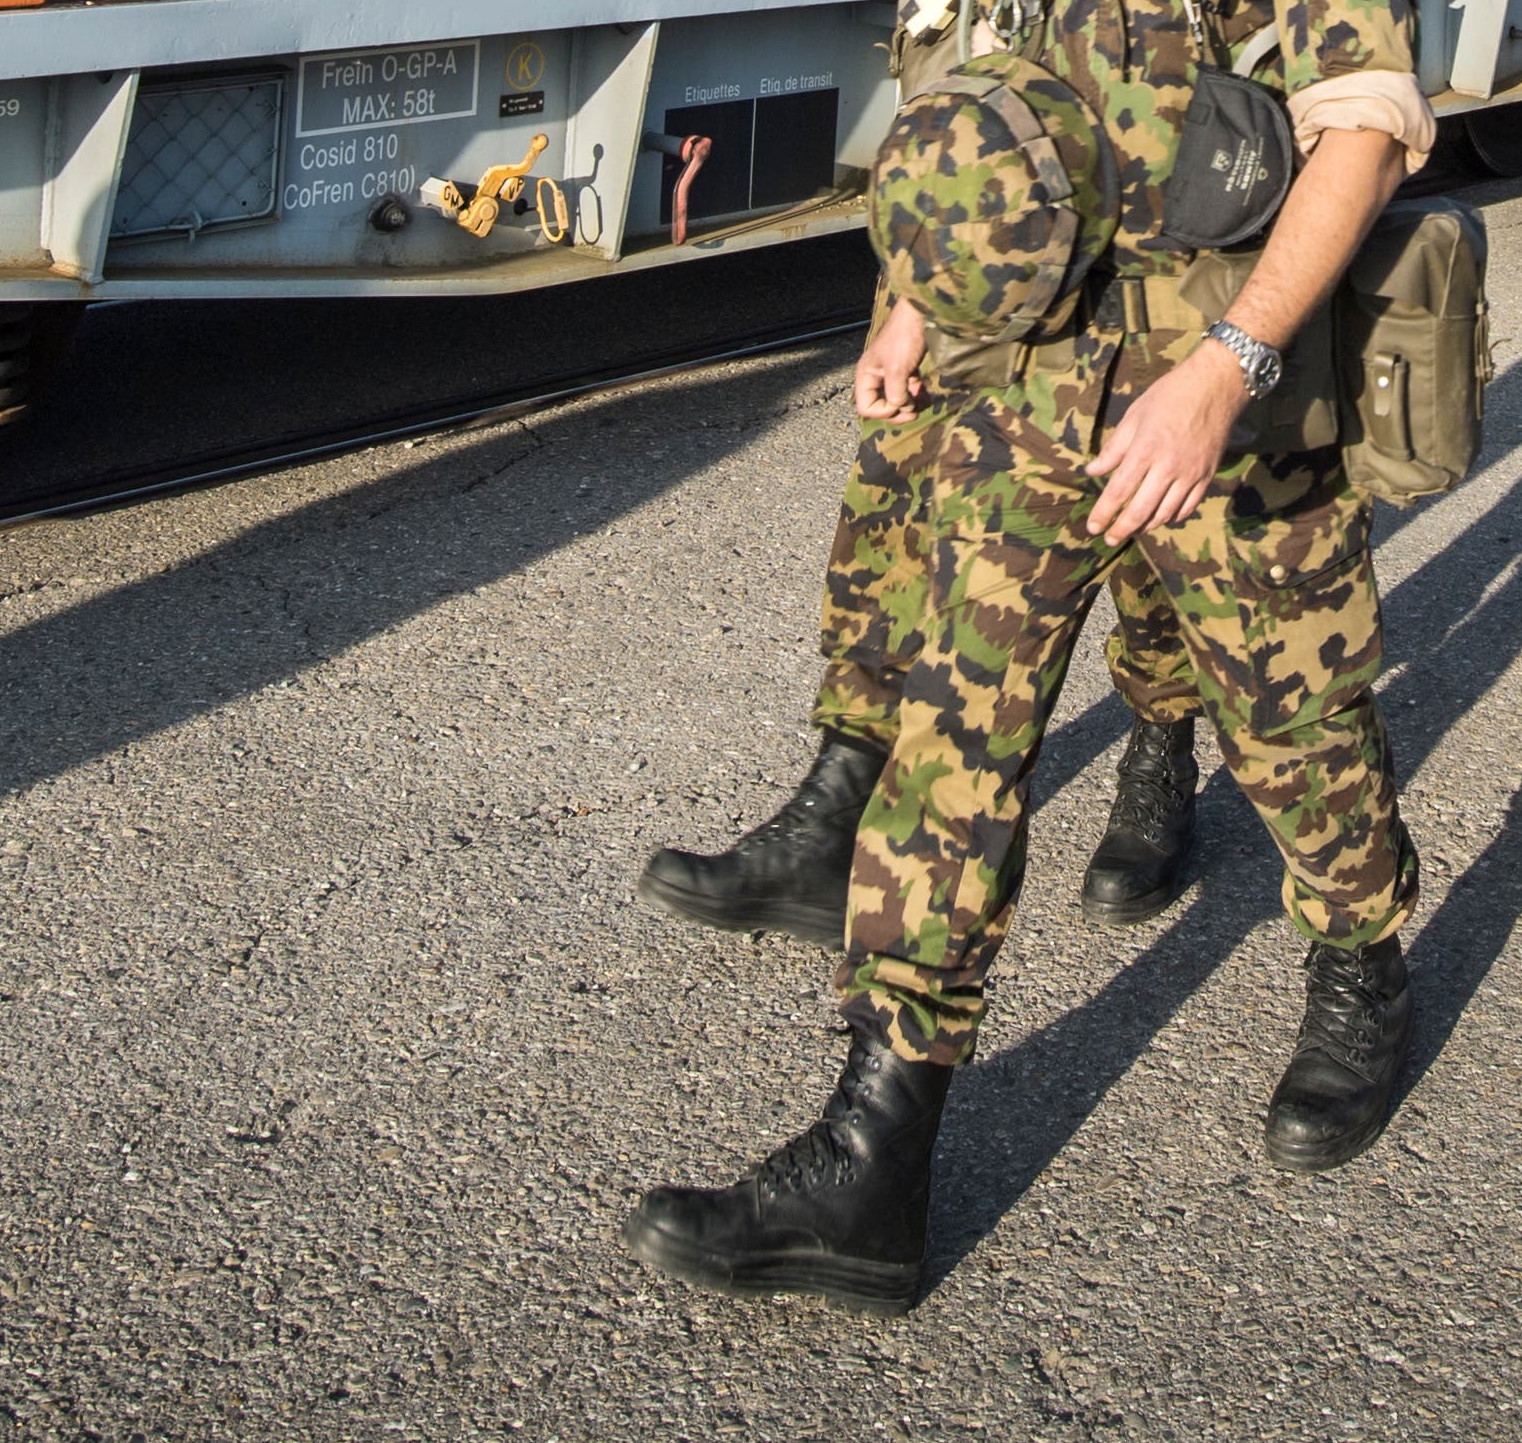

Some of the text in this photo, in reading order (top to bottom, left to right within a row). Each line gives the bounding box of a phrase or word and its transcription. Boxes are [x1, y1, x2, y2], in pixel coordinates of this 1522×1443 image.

[321, 49, 457, 89] Frein O-GP-A
[518, 51, 533, 81] K
[759, 71, 833, 95] Etiq. de transit
[342, 88, 436, 125] MAX: 58t
[684, 82, 741, 105] Etiquettes
[300, 133, 399, 171] Cosid 810
[283, 164, 416, 210] CoFren C810)
